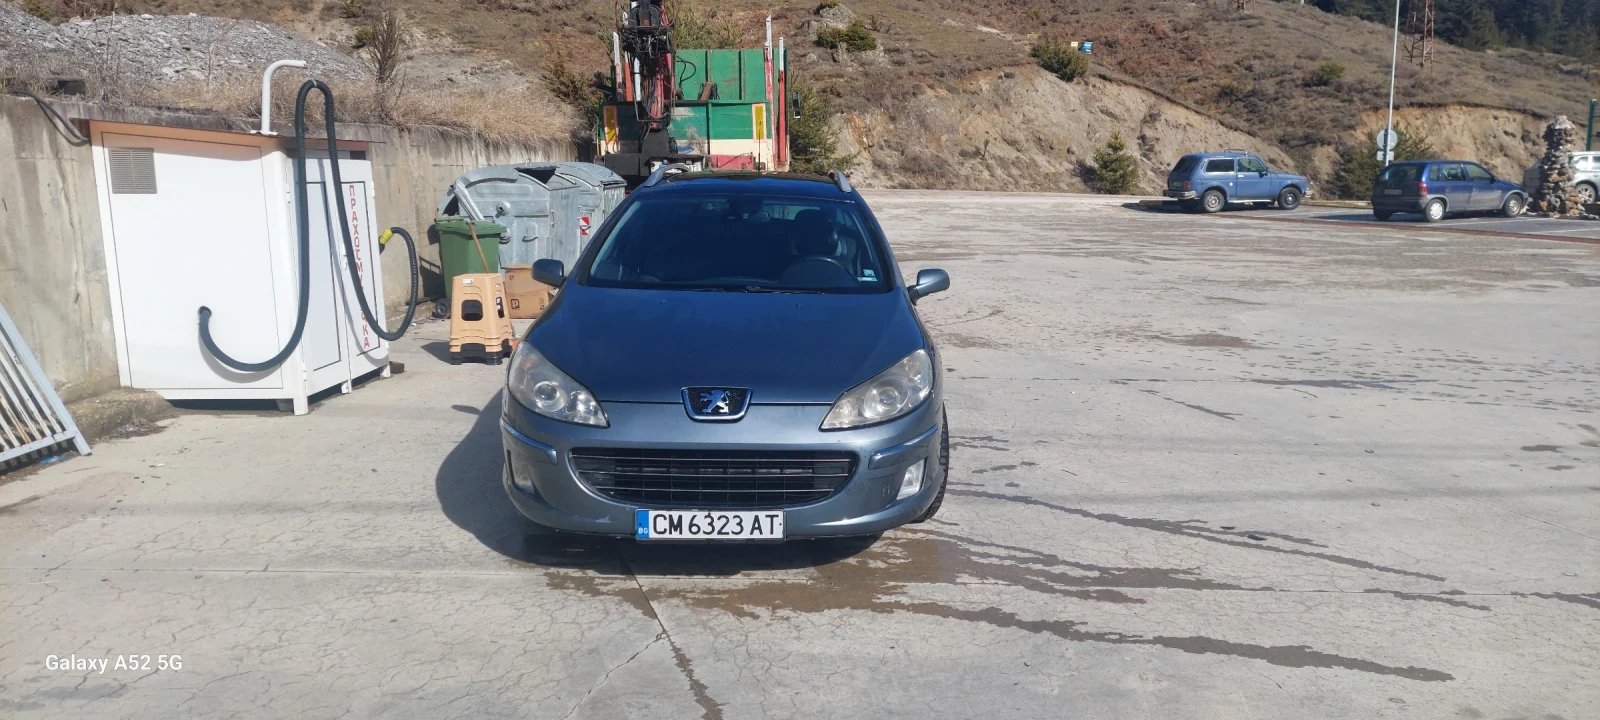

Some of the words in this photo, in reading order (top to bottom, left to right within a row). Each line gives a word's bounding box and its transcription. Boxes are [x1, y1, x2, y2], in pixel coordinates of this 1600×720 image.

[349, 185, 370, 348] ПРАХОСМЧКА
[653, 514, 683, 535] CM
[688, 514, 744, 535] 6323
[749, 514, 779, 535] AT
